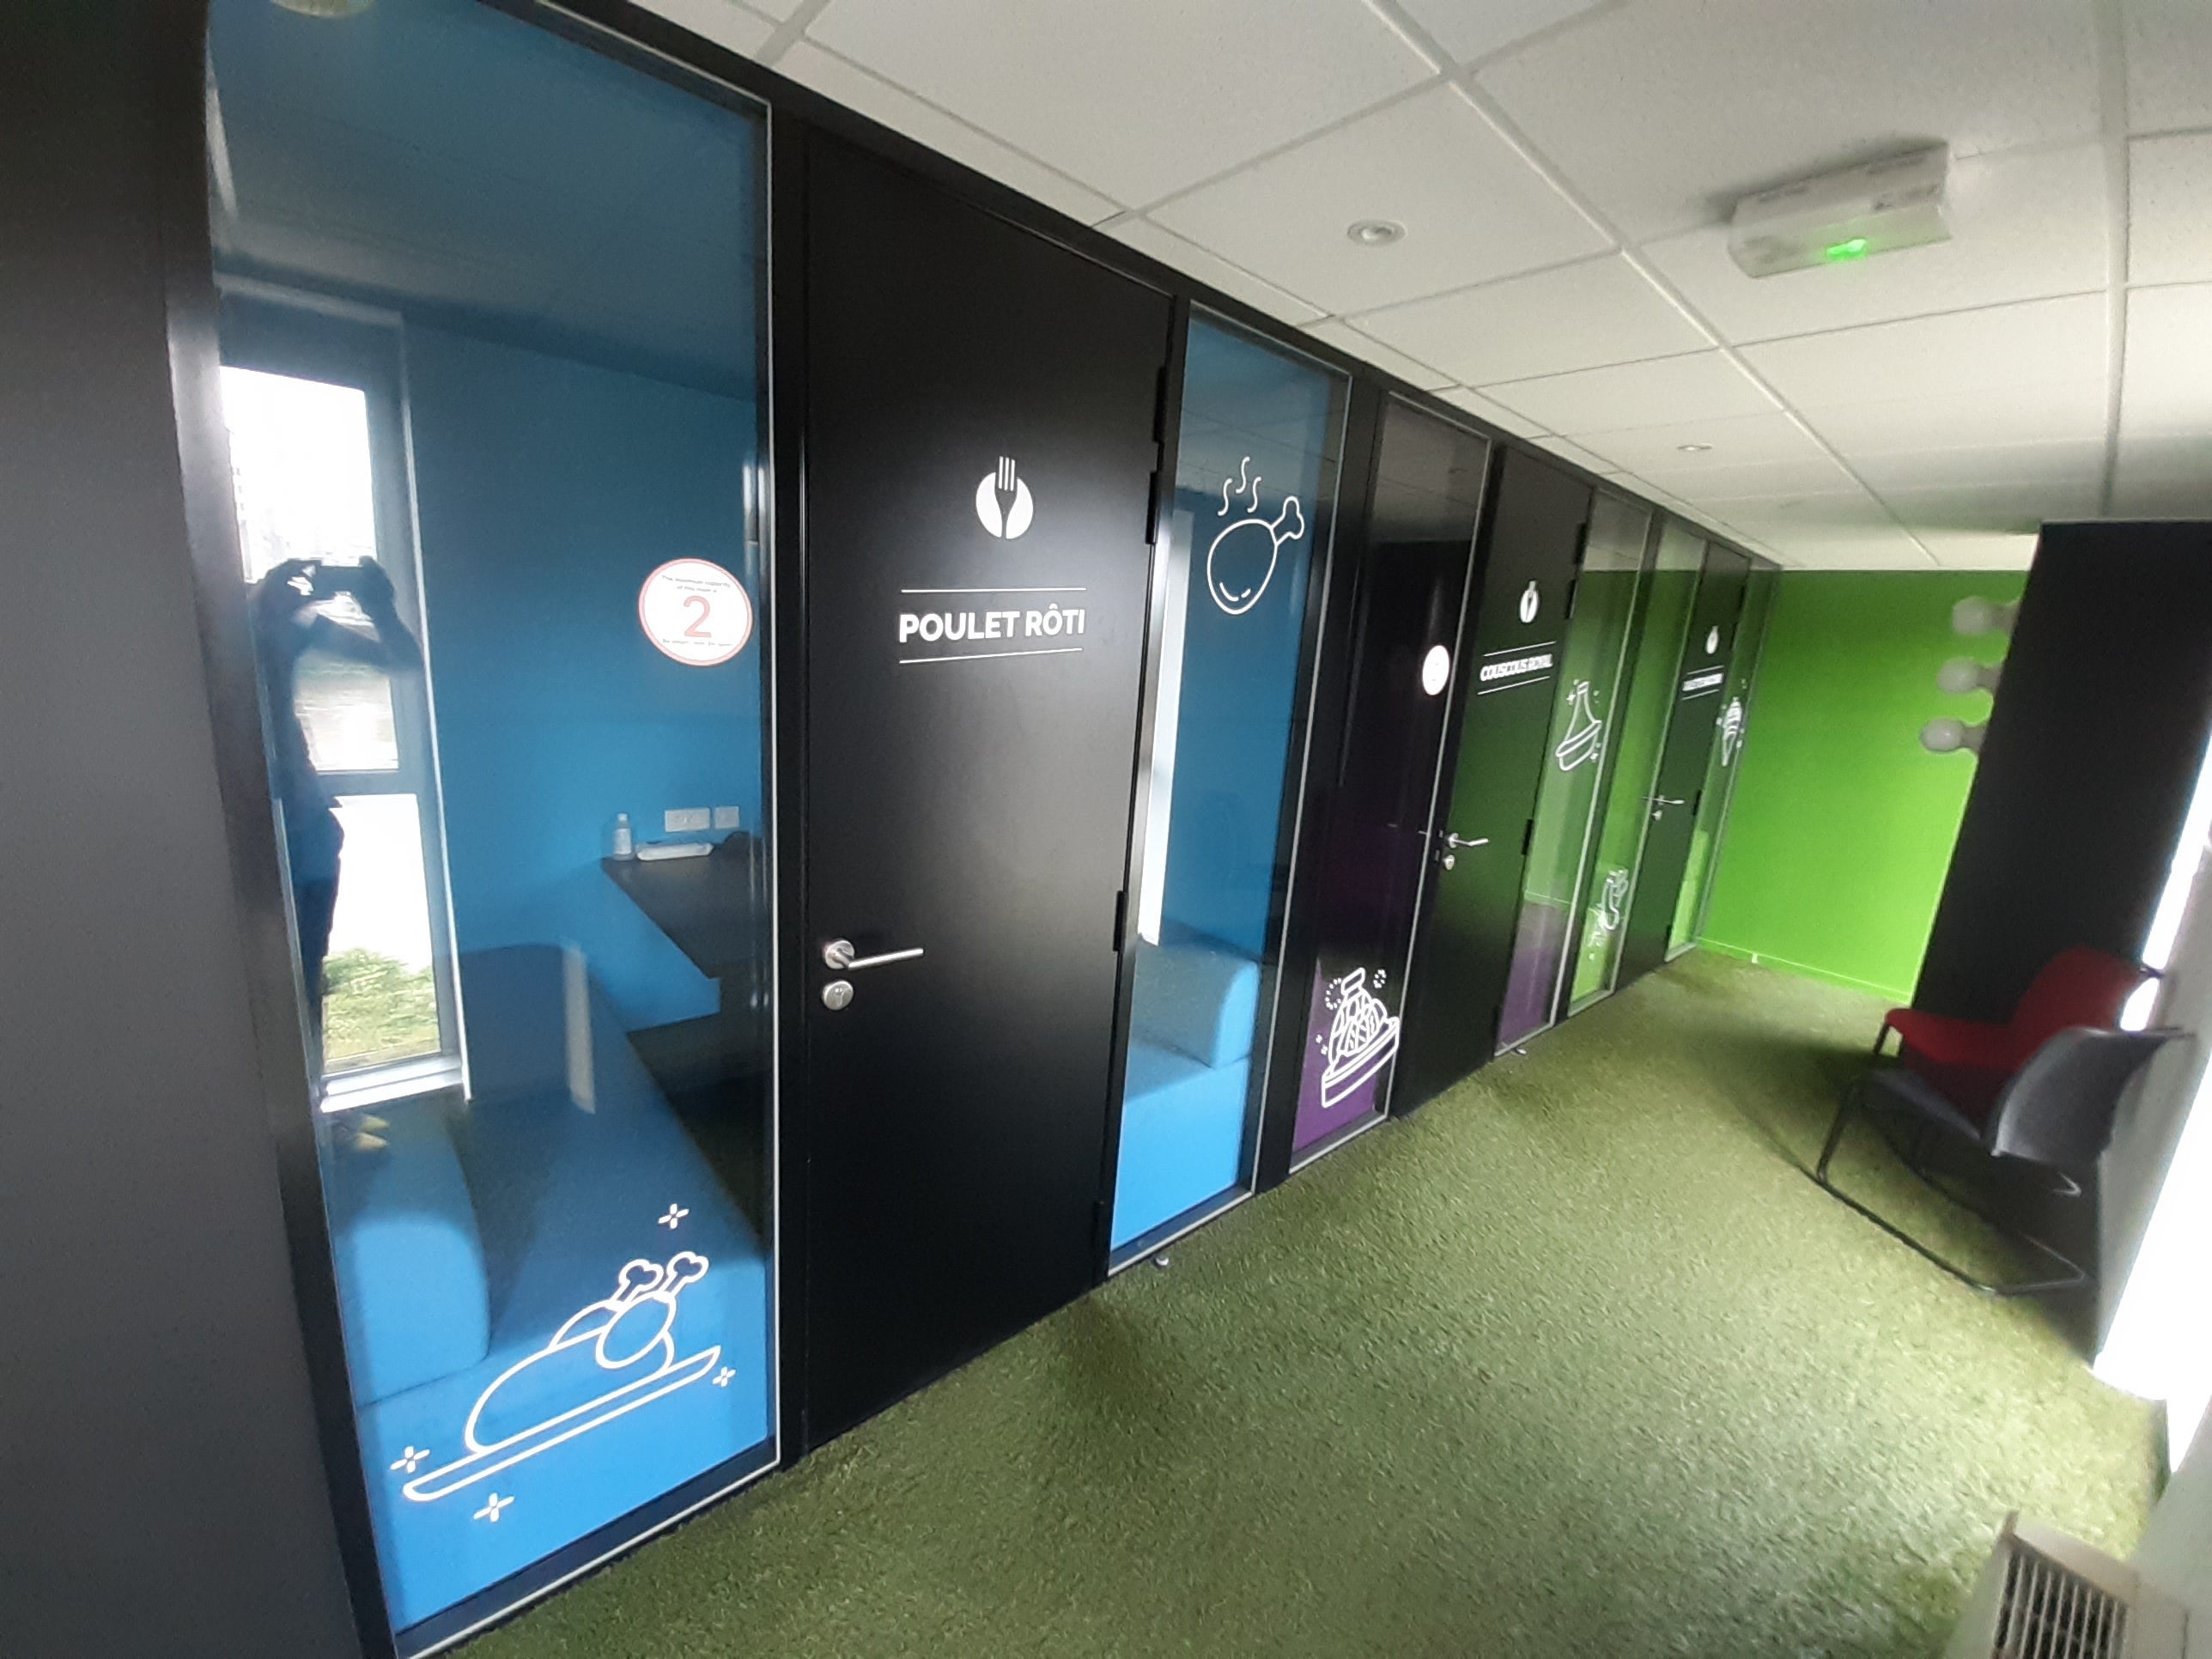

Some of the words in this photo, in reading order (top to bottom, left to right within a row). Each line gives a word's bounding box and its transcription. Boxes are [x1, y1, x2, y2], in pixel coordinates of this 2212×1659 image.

[684, 595, 712, 638] 2
[899, 611, 1020, 643] POULET
[1025, 603, 1085, 637] RÔTI
